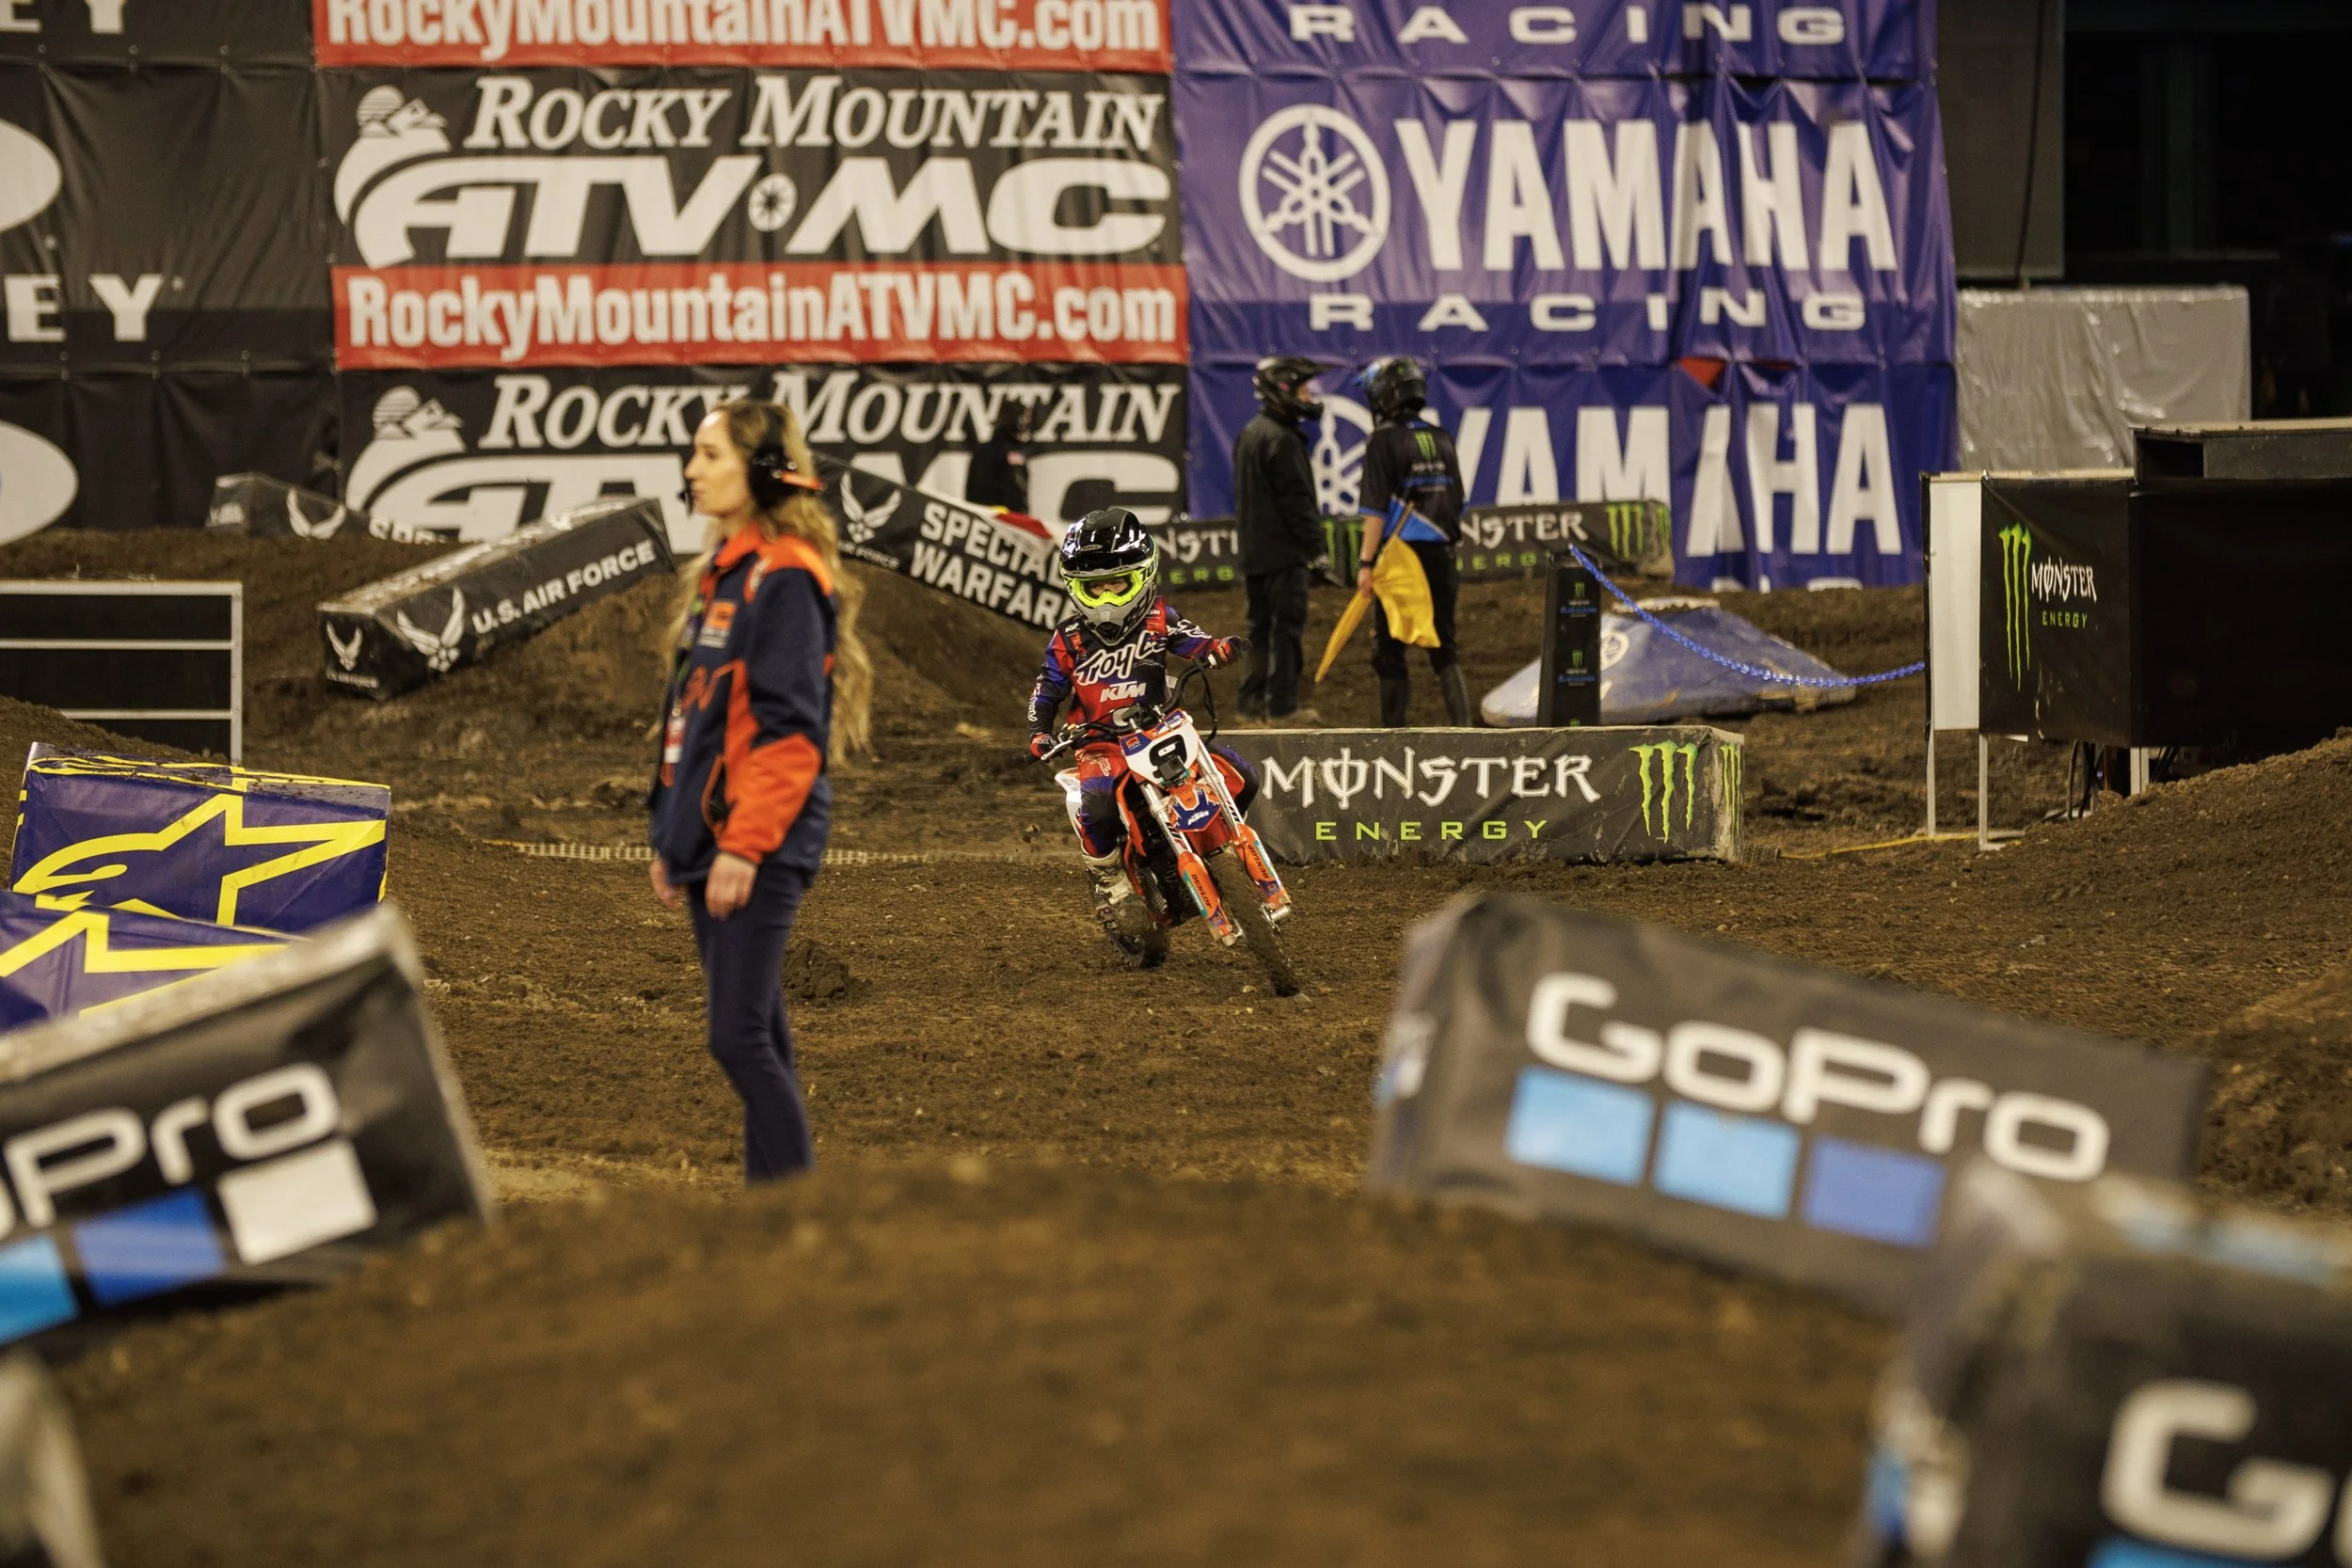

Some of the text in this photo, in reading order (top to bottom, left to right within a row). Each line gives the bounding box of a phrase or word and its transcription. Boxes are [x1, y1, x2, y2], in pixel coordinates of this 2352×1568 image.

[1290, 2, 1846, 44] RACING
[463, 74, 1166, 150] ROCKY MOUNTAIN
[1394, 119, 1898, 271] YAMAHA
[347, 272, 1177, 362] RockyMountainATVMC.com
[1309, 288, 1867, 332] RACING
[472, 539, 658, 635] U.S. AIR FORCE
[2031, 555, 2097, 604] MONSTER
[2042, 610, 2088, 629] ENERGY
[1100, 681, 1147, 703] KTM
[1149, 734, 1187, 780] 9
[1262, 746, 1601, 810] MONSTER
[1315, 819, 1549, 841] ENERGY
[1247, 844, 1270, 879] DUNLOP
[1191, 873, 1213, 909] DUNLOP
[1525, 972, 2111, 1182] GoPro
[0, 1061, 340, 1240] Pro
